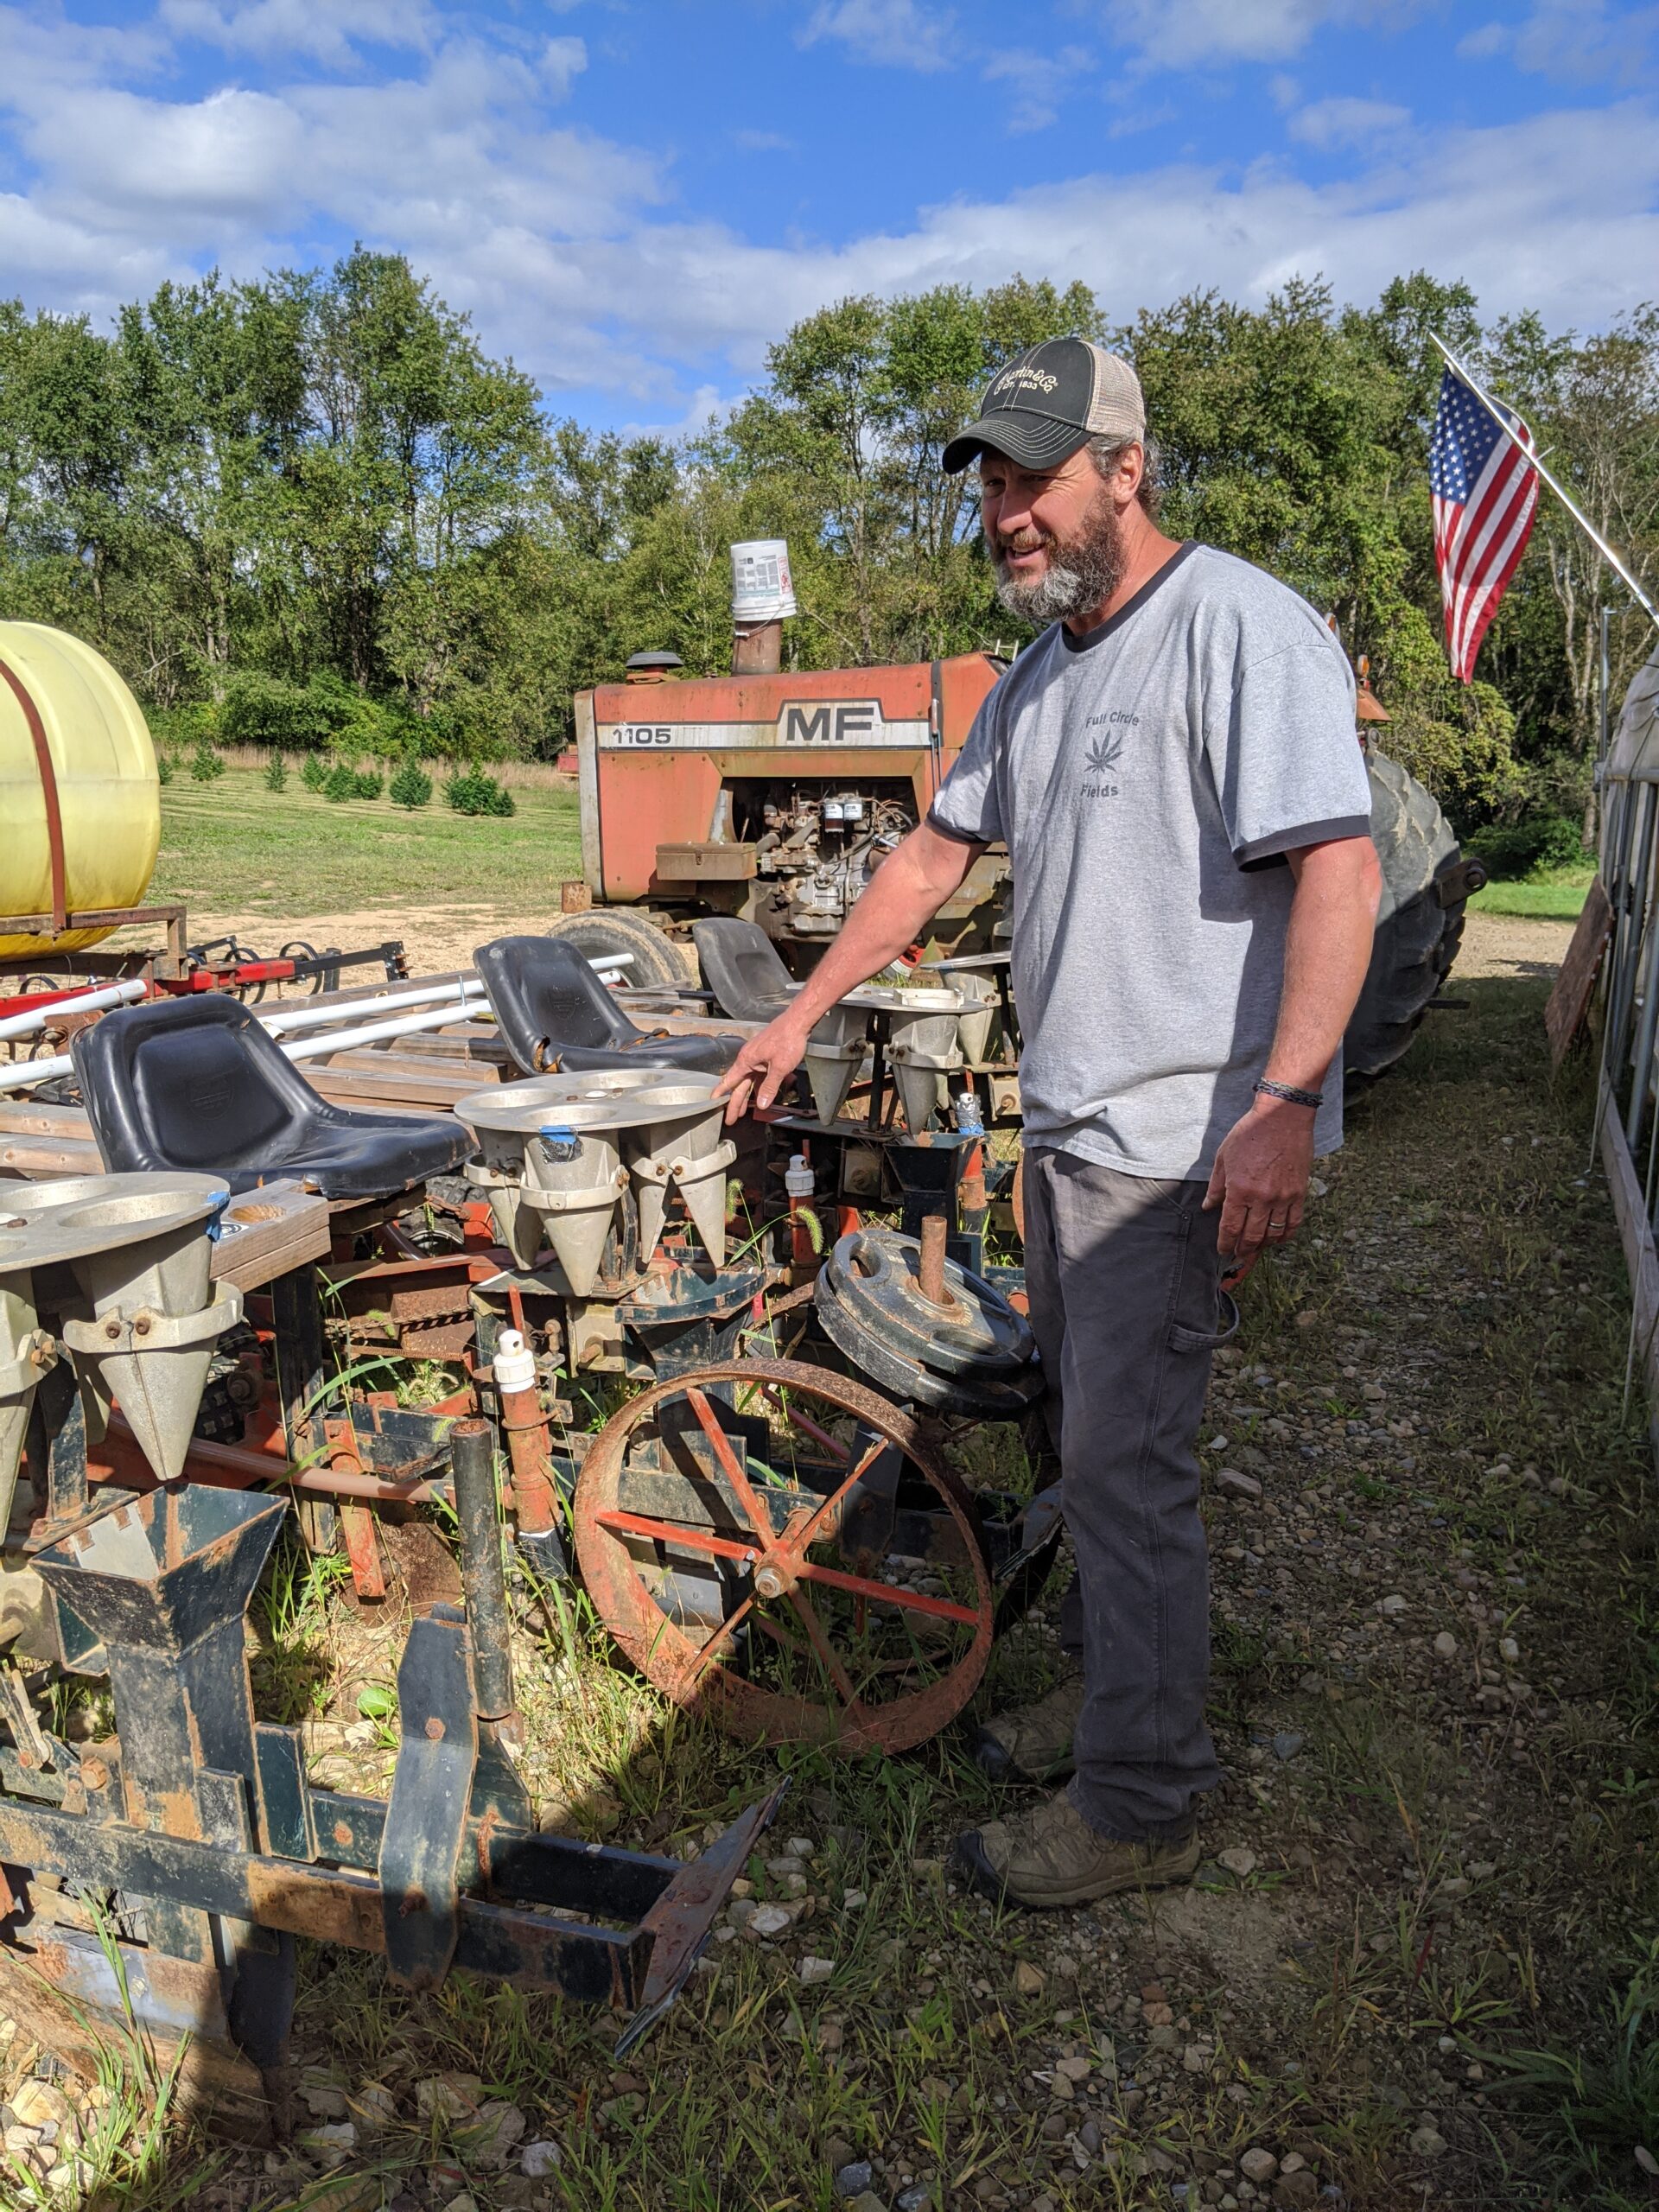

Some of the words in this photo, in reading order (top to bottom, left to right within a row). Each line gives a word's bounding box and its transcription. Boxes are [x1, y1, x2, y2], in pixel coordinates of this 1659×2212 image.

[1019, 380, 1038, 390] 1833
[786, 707, 874, 741] MF
[1085, 713, 1107, 728] Full
[1109, 710, 1140, 727] Circle
[613, 728, 671, 744] 1105
[1080, 784, 1119, 798] Fields
